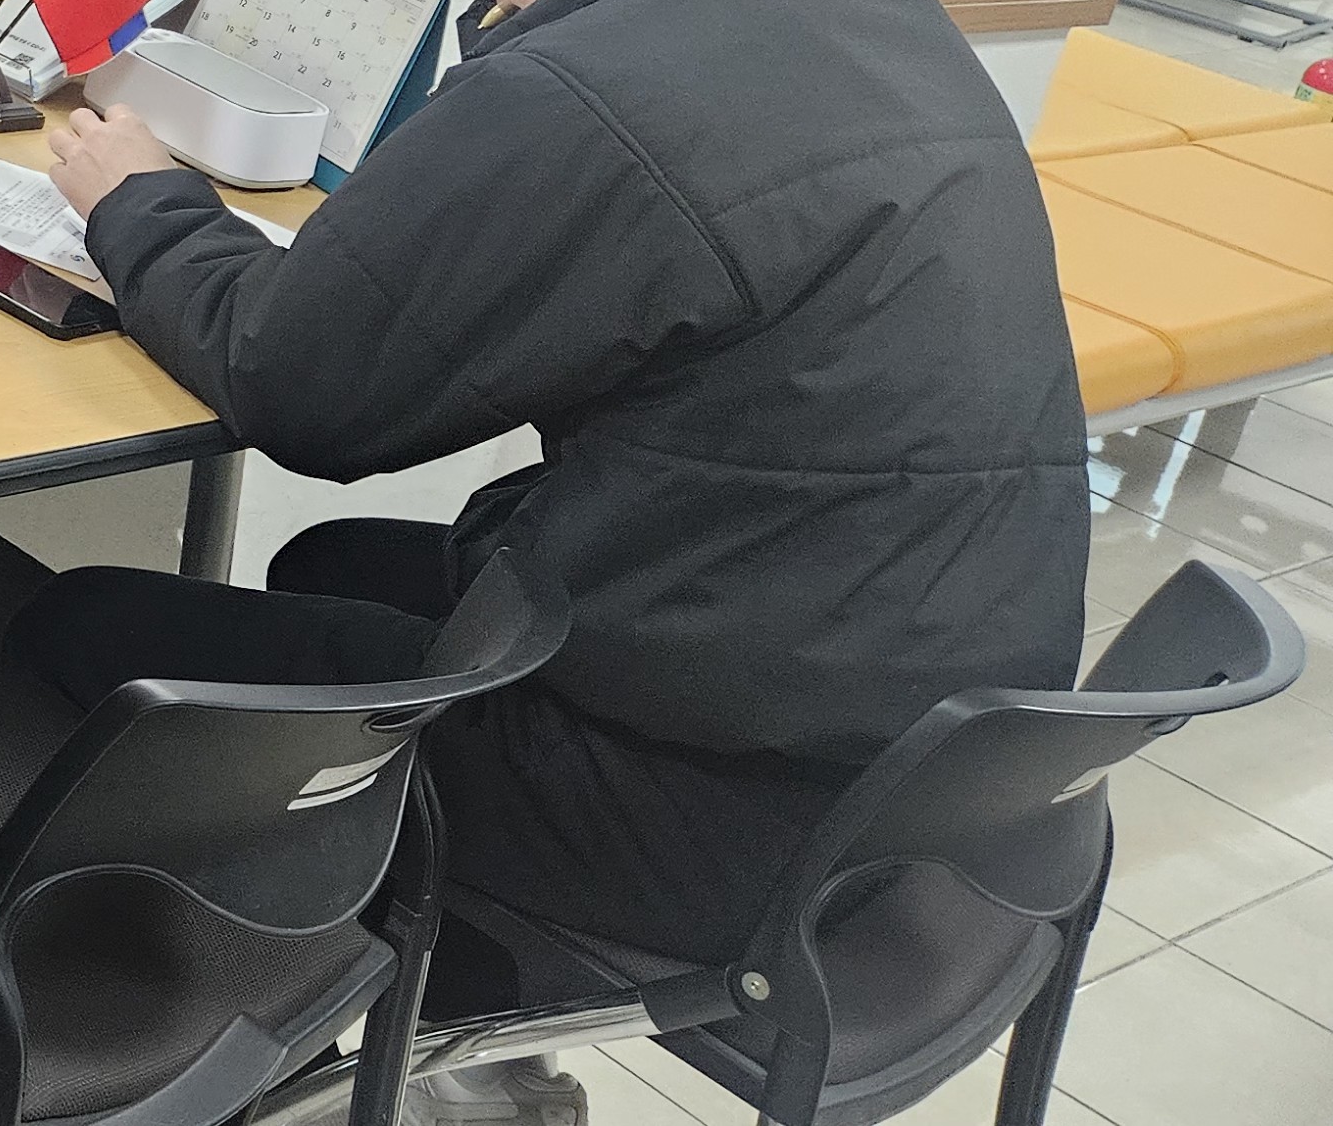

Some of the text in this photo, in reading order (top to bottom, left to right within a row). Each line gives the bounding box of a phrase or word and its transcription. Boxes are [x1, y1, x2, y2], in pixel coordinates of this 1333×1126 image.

[263, 11, 272, 20] 13
[287, 24, 296, 34] 14
[311, 36, 321, 47] 15
[337, 50, 346, 60] 16
[325, 9, 331, 18] 8
[350, 22, 357, 31] 9
[200, 11, 210, 21] 18
[225, 24, 234, 34] 19
[248, 37, 259, 47] 20
[273, 50, 283, 60] 21
[297, 63, 308, 74] 22
[322, 78, 332, 88] 23
[333, 120, 342, 129] 31
